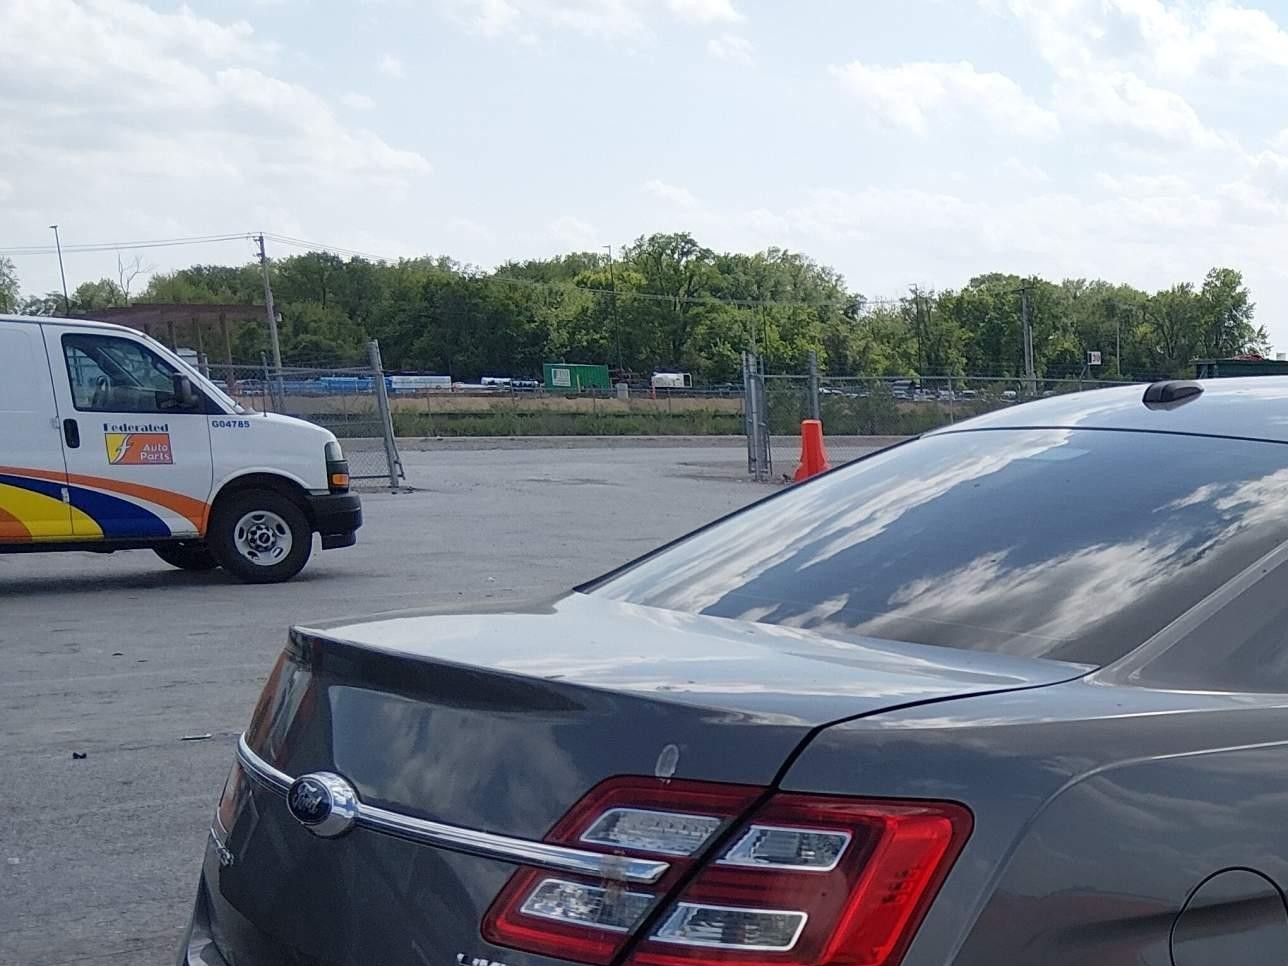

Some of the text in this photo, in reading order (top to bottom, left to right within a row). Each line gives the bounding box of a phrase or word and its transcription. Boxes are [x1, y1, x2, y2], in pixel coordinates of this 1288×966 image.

[103, 422, 169, 432] Federated
[211, 420, 250, 428] G04785
[143, 443, 168, 452] Auto
[140, 452, 170, 461] Parts
